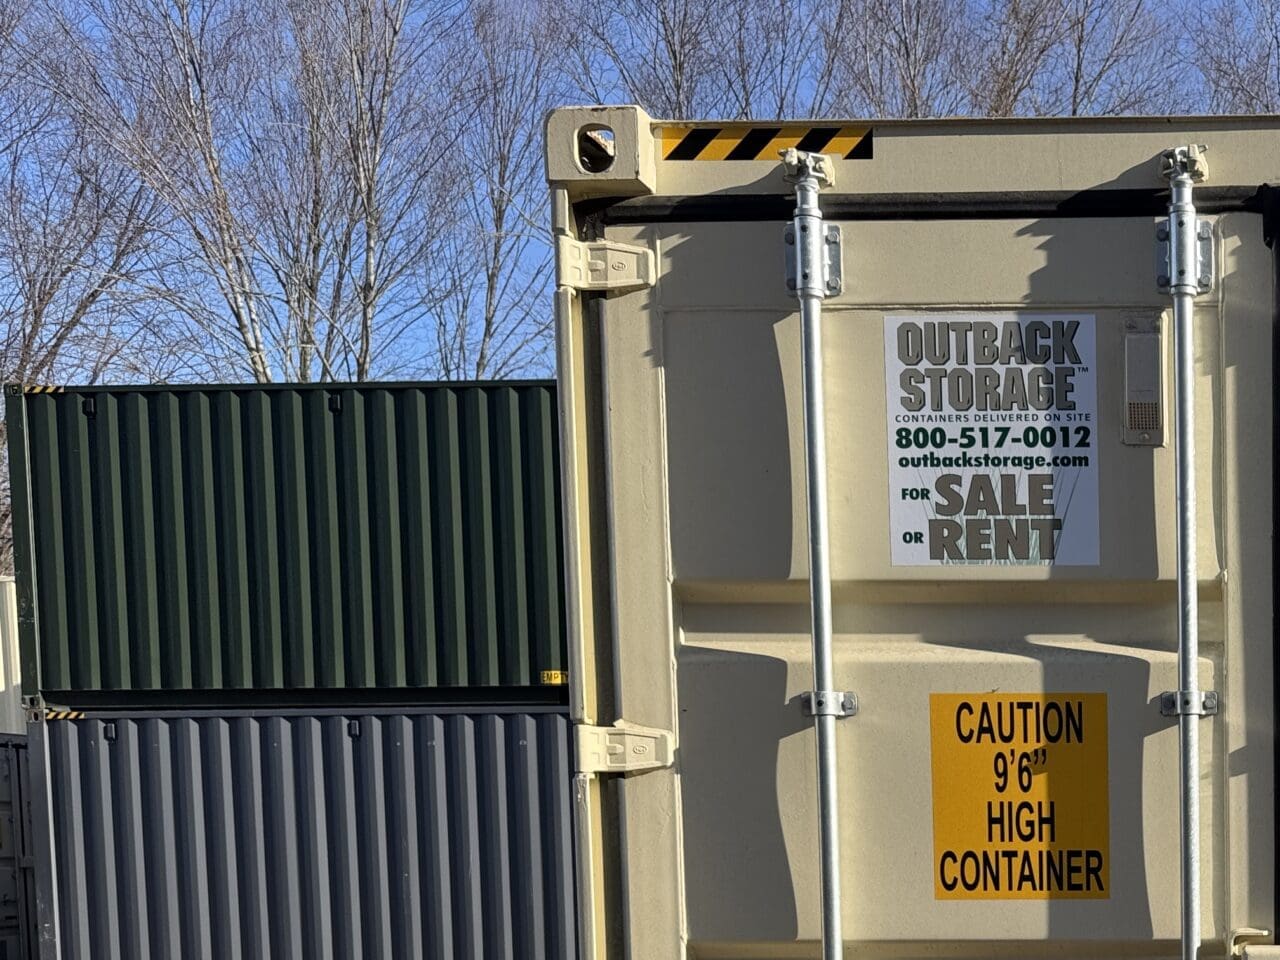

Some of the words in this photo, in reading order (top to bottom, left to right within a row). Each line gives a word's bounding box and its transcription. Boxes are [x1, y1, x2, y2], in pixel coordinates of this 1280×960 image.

[897, 321, 1082, 365] OUTBACK
[900, 367, 1076, 412] STORAGE
[895, 414, 969, 423] CONTAINERS
[974, 413, 1039, 422] DELIVERED
[1044, 413, 1061, 422] ON
[1064, 412, 1091, 422] SITE
[895, 426, 1091, 449] 800-517-0012
[898, 452, 1089, 470] outbackstorage.com
[901, 488, 931, 500] FOR
[934, 473, 1055, 516] SALE
[902, 531, 924, 543] OR
[928, 519, 1062, 561] RENT
[956, 701, 1083, 744] CAUTION
[987, 801, 1056, 843] HIGH
[939, 850, 1105, 892] CONTAINER
